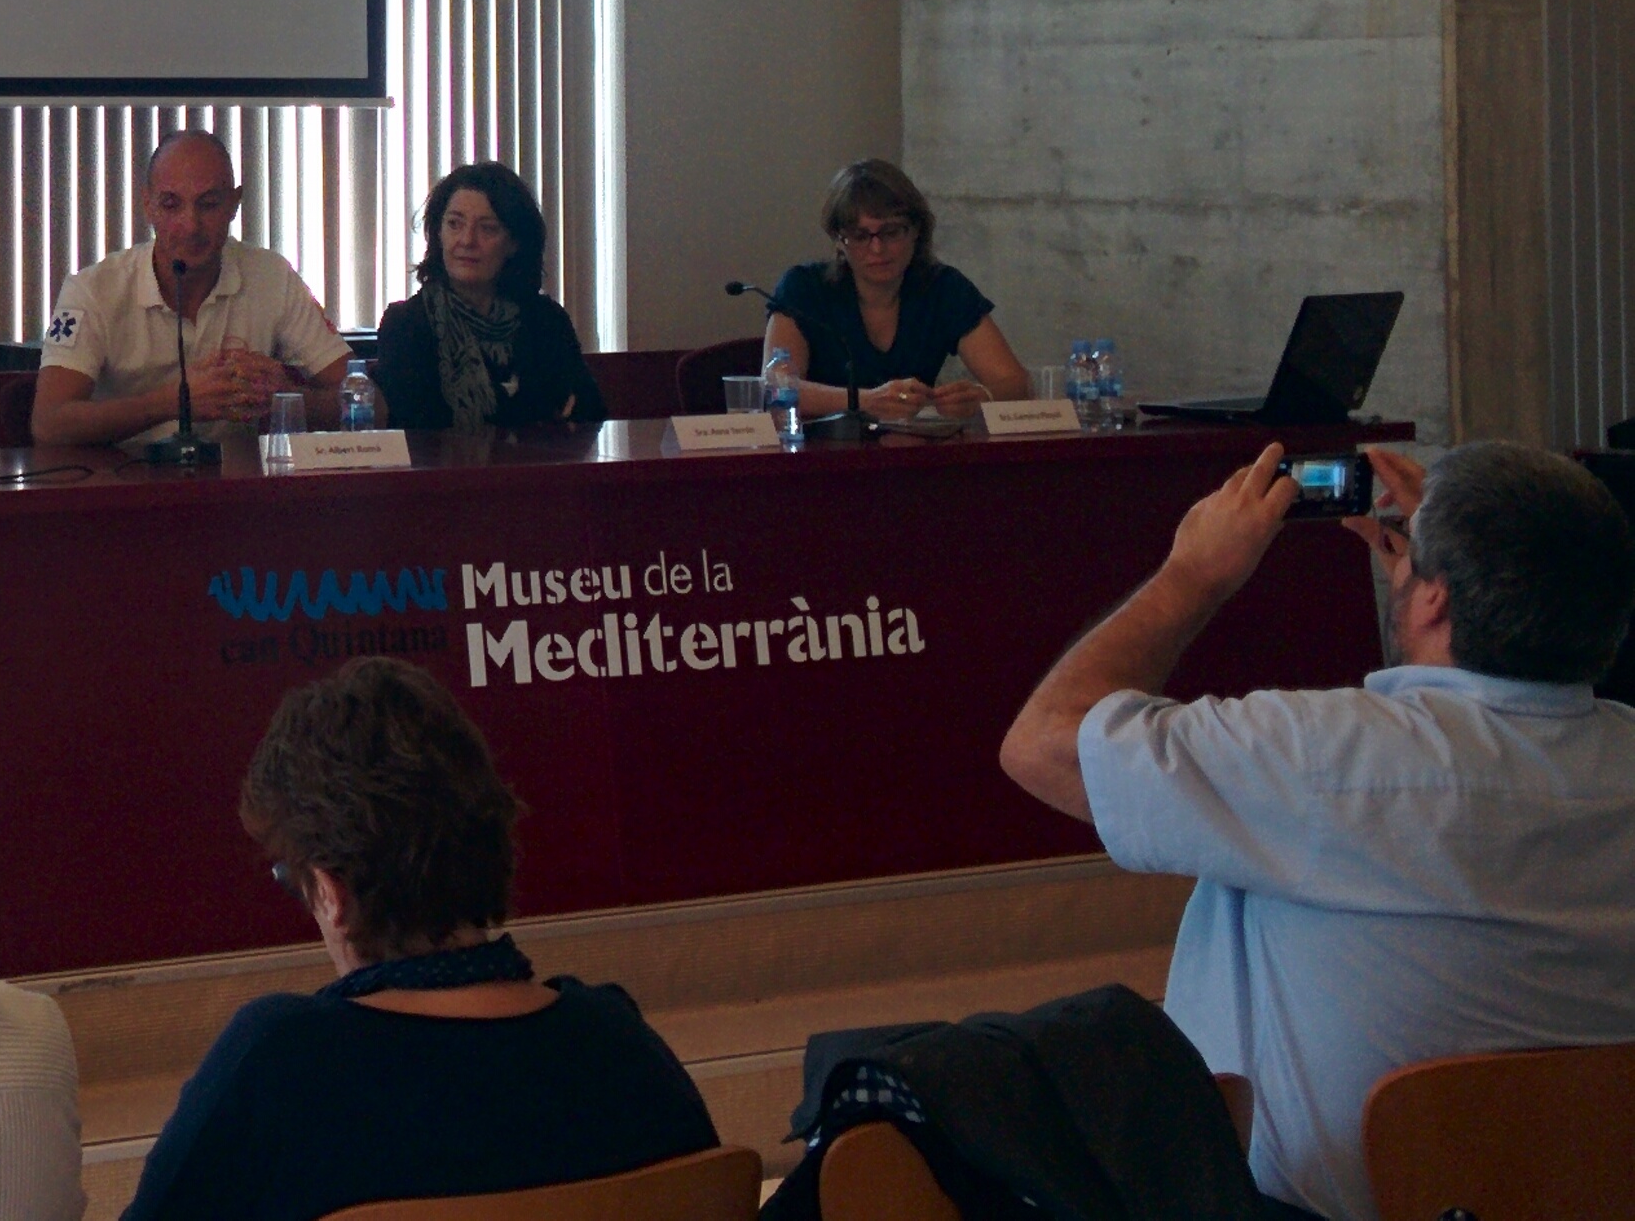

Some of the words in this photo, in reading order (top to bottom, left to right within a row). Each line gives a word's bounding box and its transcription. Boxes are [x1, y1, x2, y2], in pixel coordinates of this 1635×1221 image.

[462, 562, 633, 609] Museu
[644, 552, 693, 597] de
[702, 548, 734, 593] la
[465, 595, 926, 687] Mediterrània
